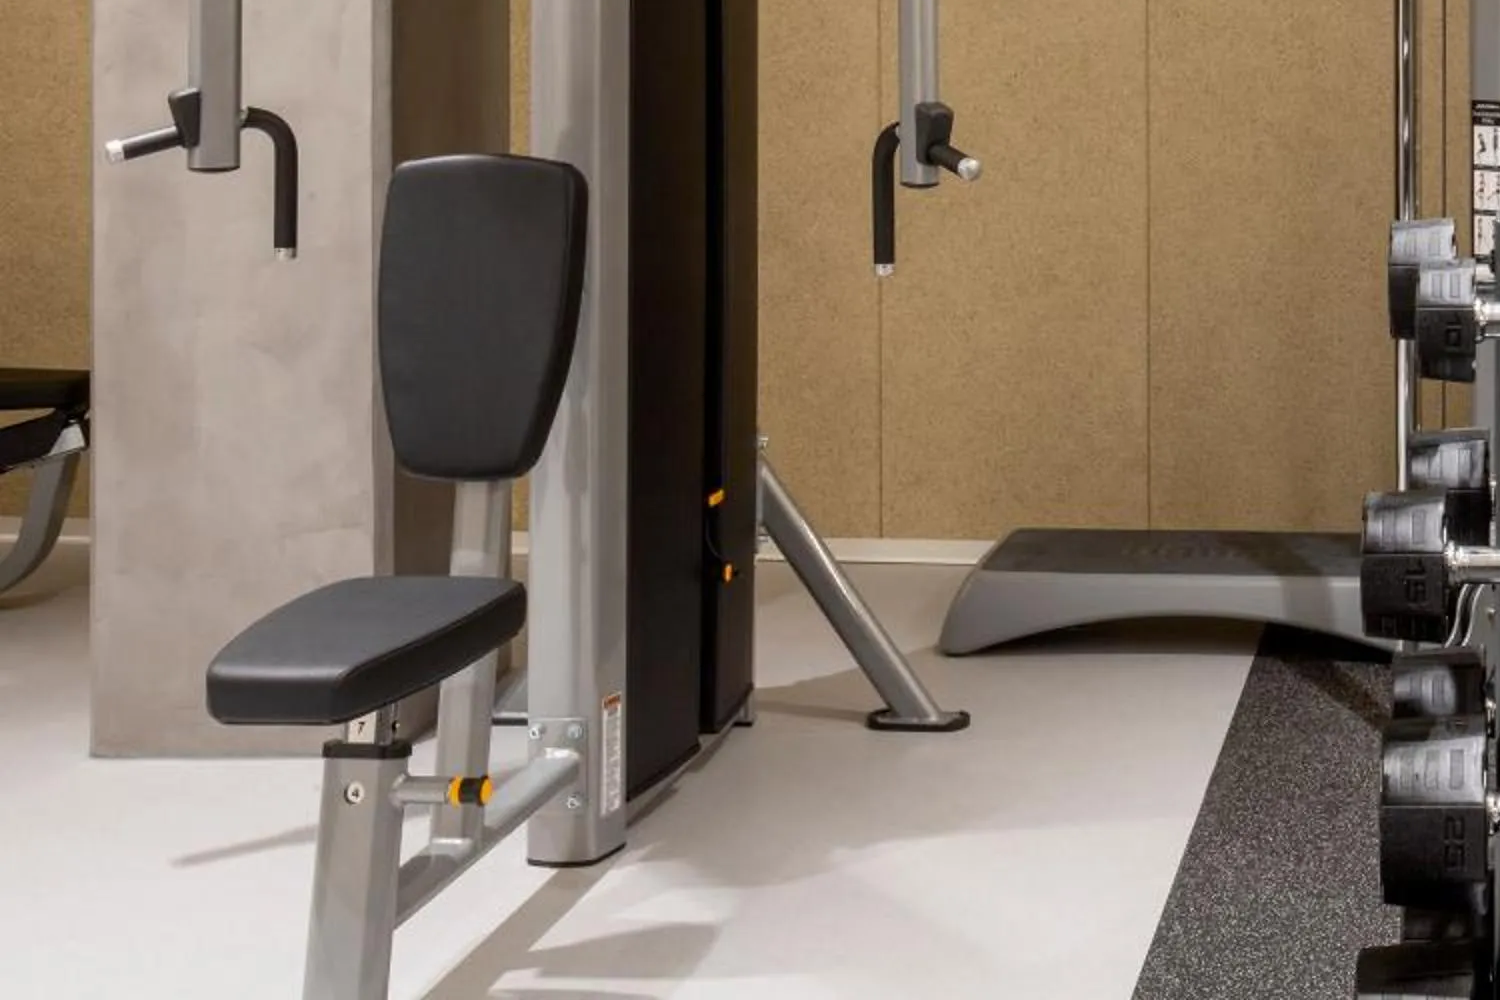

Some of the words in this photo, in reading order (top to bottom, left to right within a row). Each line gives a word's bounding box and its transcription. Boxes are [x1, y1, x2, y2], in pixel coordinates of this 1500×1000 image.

[357, 721, 366, 735] 7
[351, 787, 360, 800] 4
[1444, 815, 1466, 873] 25
